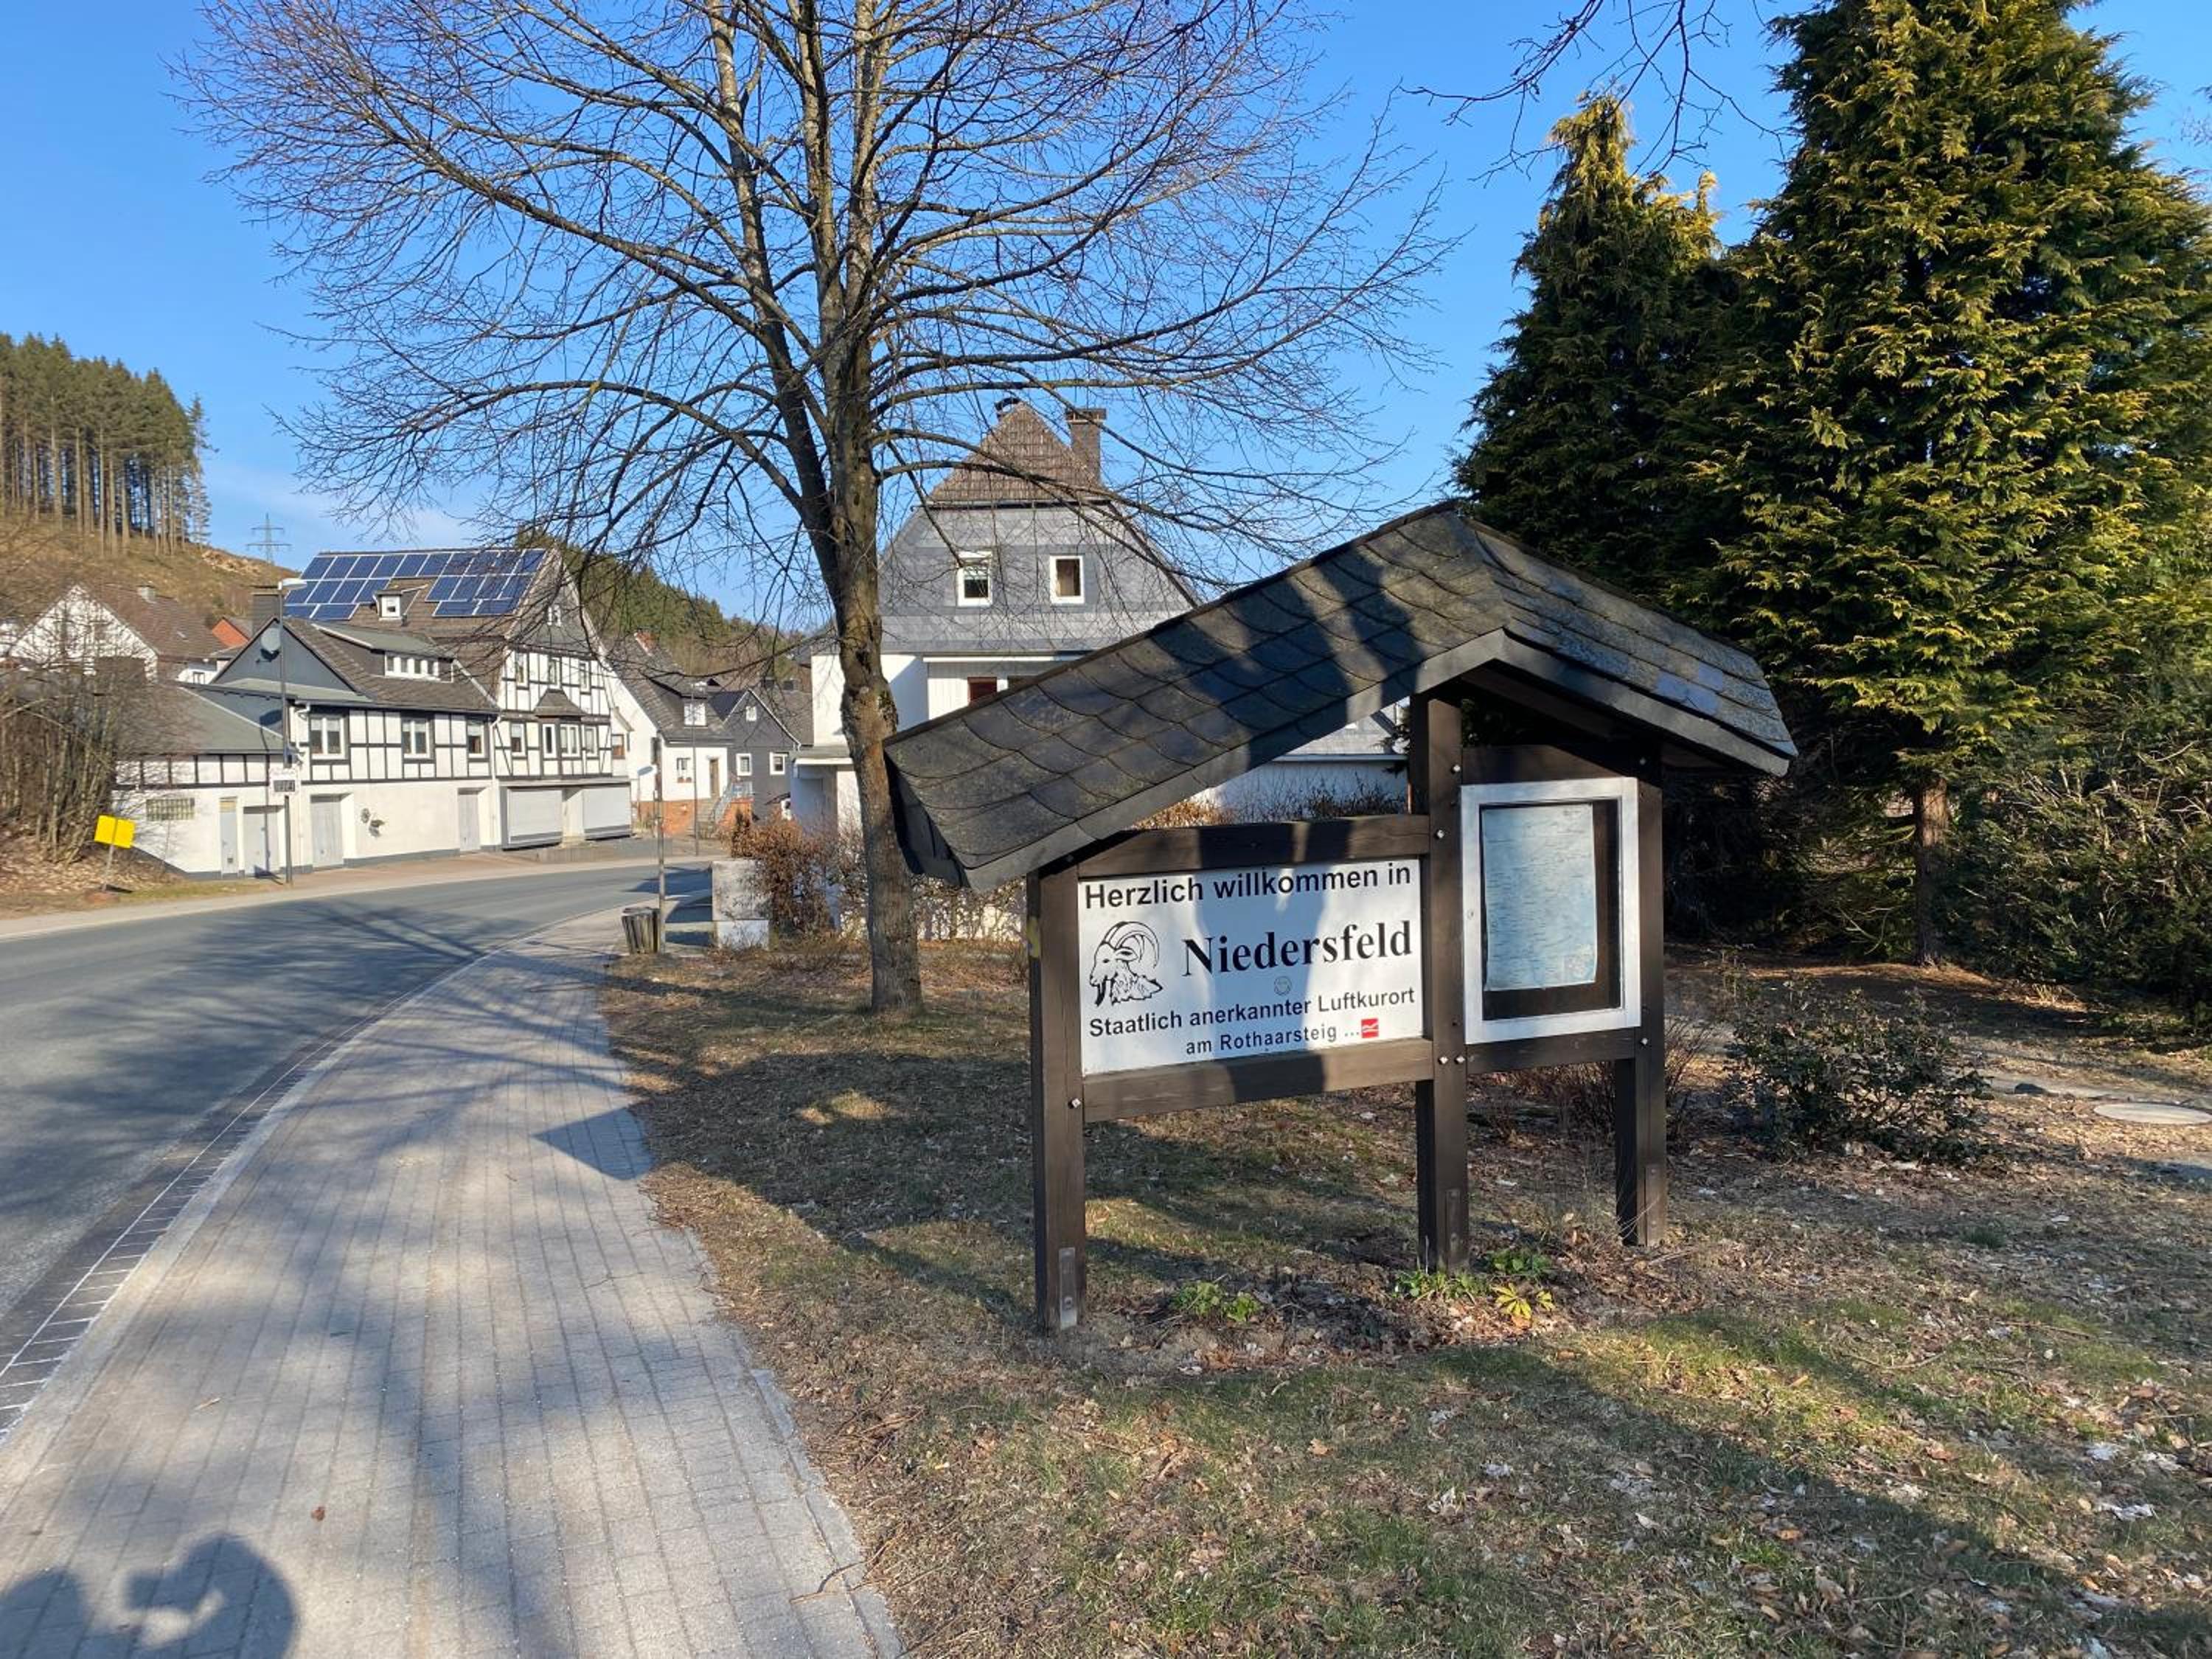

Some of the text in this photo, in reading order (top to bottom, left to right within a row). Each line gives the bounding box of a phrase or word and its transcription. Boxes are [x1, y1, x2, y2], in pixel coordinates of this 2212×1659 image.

[1085, 862, 1411, 909] Herzlich willkommen in
[1181, 920, 1412, 978] Niedersfeld
[1089, 987, 1416, 1037] Staatlich anerkannter Luftkurort
[1186, 1040, 1211, 1055] am
[1220, 1022, 1337, 1052] Rothaarsteig
